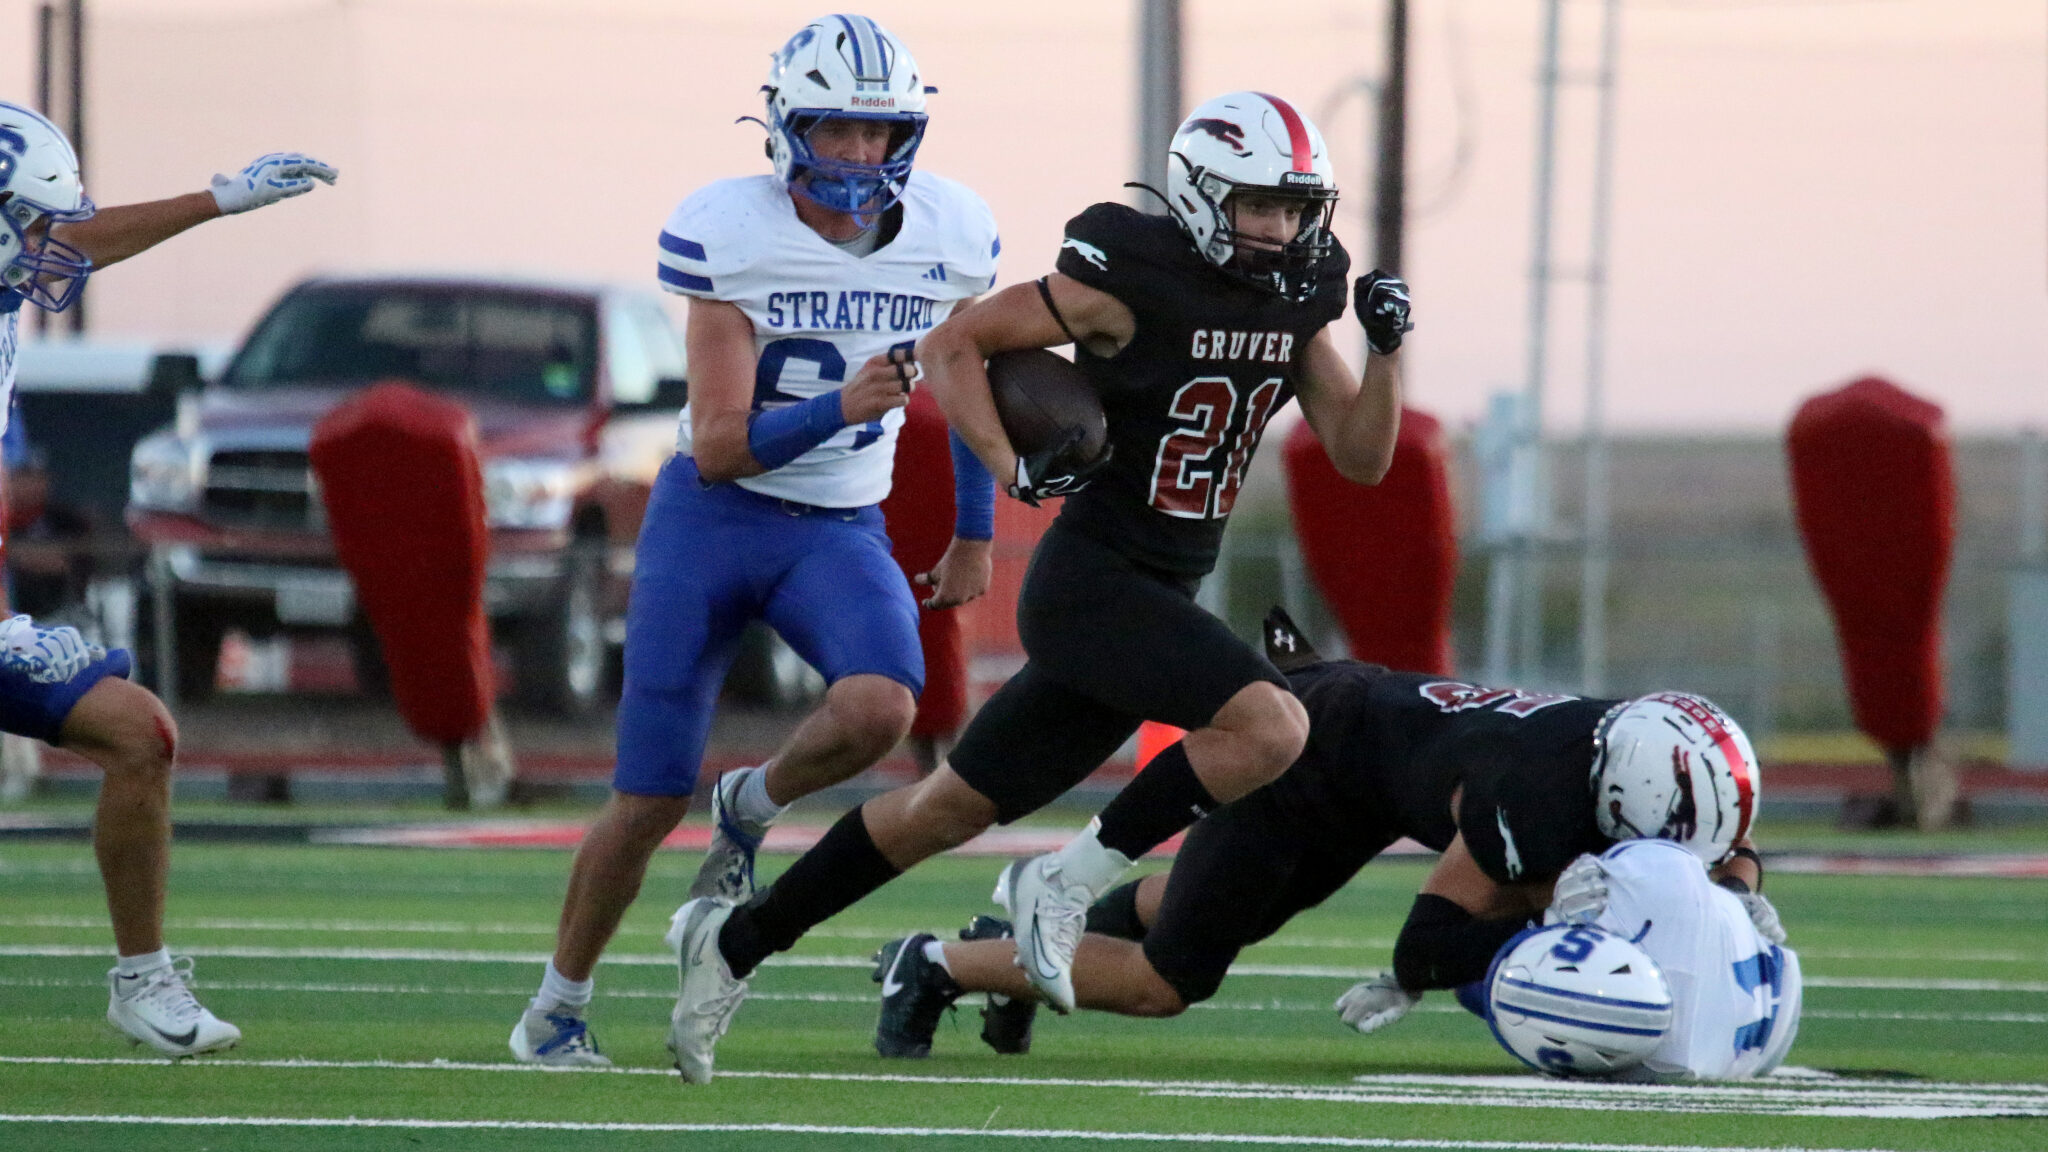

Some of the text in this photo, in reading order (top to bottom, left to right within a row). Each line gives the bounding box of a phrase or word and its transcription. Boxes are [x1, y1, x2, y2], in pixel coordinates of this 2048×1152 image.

[851, 96, 895, 108] Riddell
[1286, 173, 1321, 186] Riddell
[1191, 329, 1294, 363] GRUVER
[1148, 376, 1283, 519] 21
